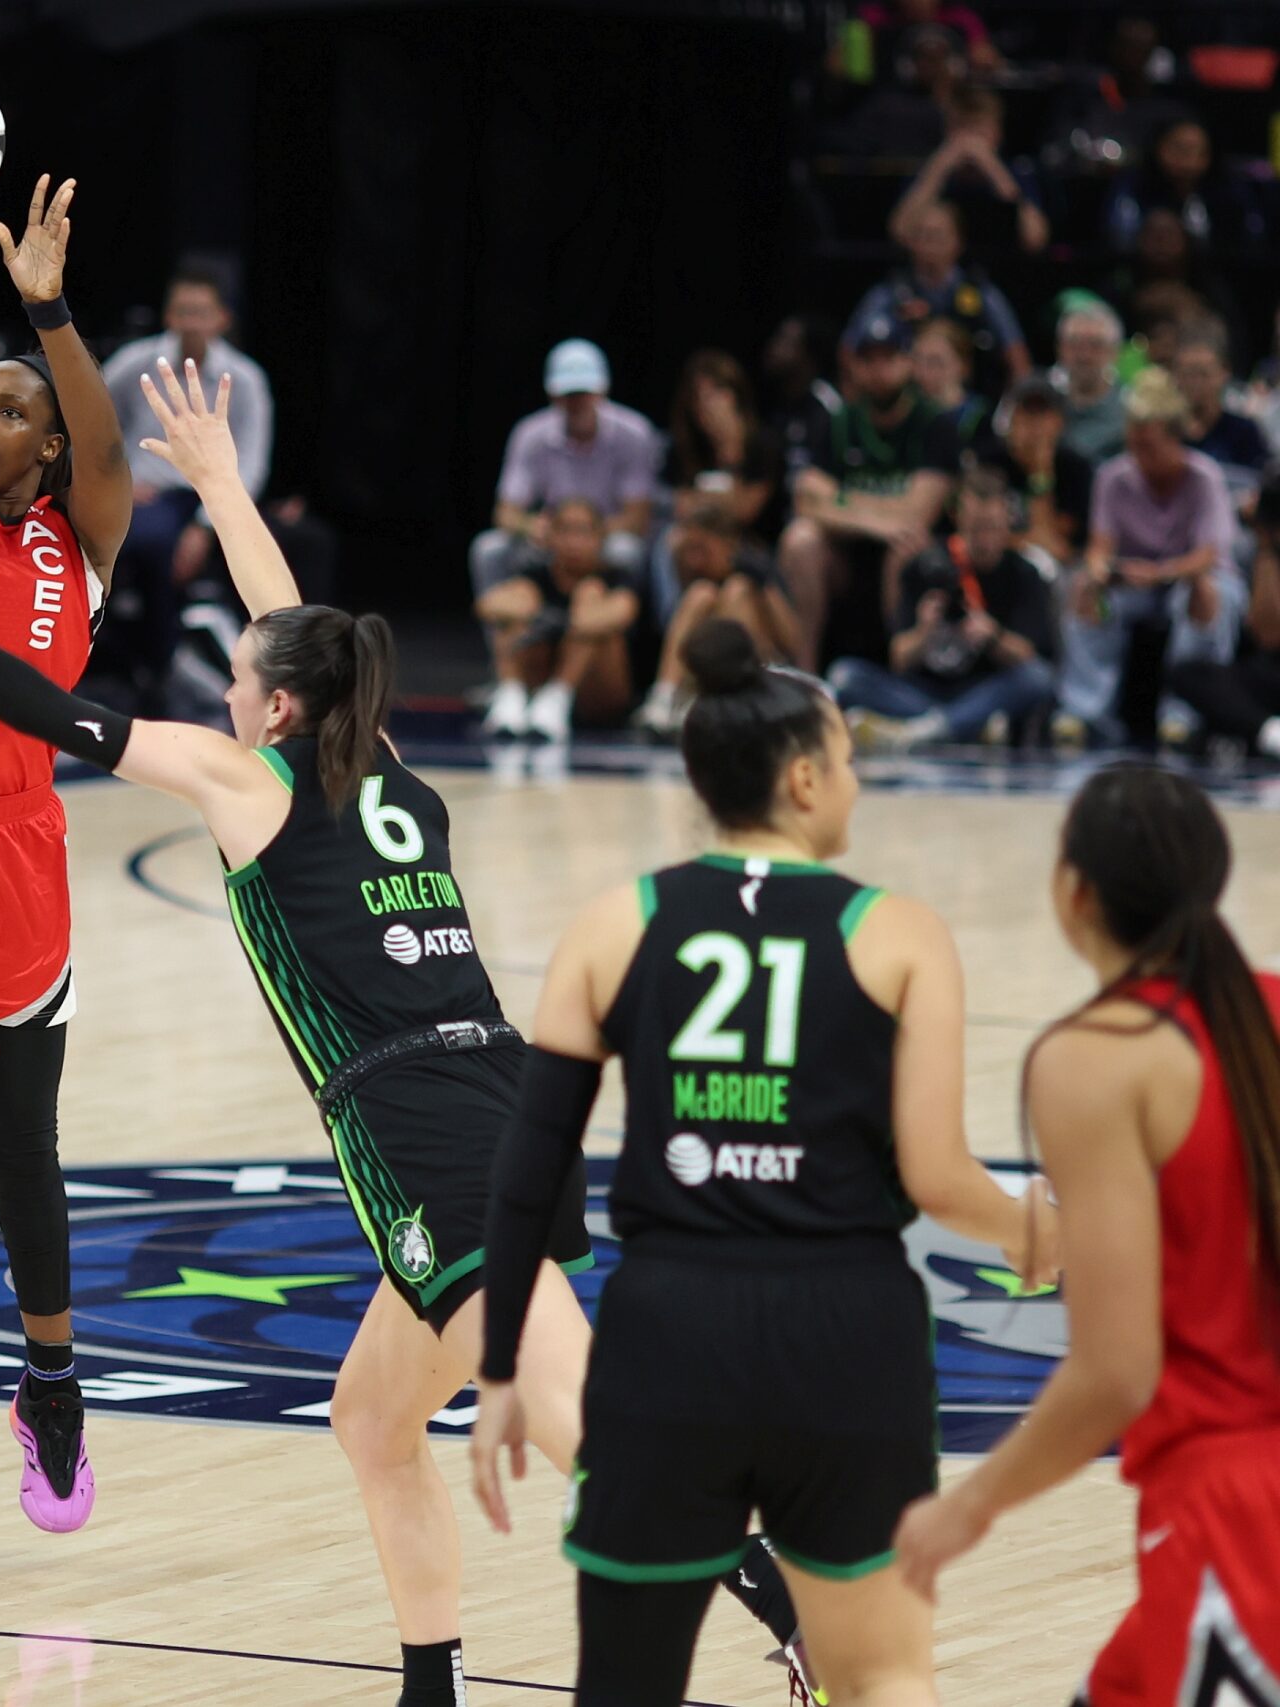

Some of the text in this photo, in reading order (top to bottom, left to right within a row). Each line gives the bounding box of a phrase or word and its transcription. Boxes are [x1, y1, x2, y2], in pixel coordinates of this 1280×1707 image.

[22, 520, 65, 650] ACES
[358, 775, 424, 864] 6
[360, 872, 461, 916] CARLETON
[423, 927, 473, 957] AT&T
[668, 930, 807, 1067] 21
[672, 1071, 790, 1124] McBRIDE
[714, 1141, 805, 1183] AT&T
